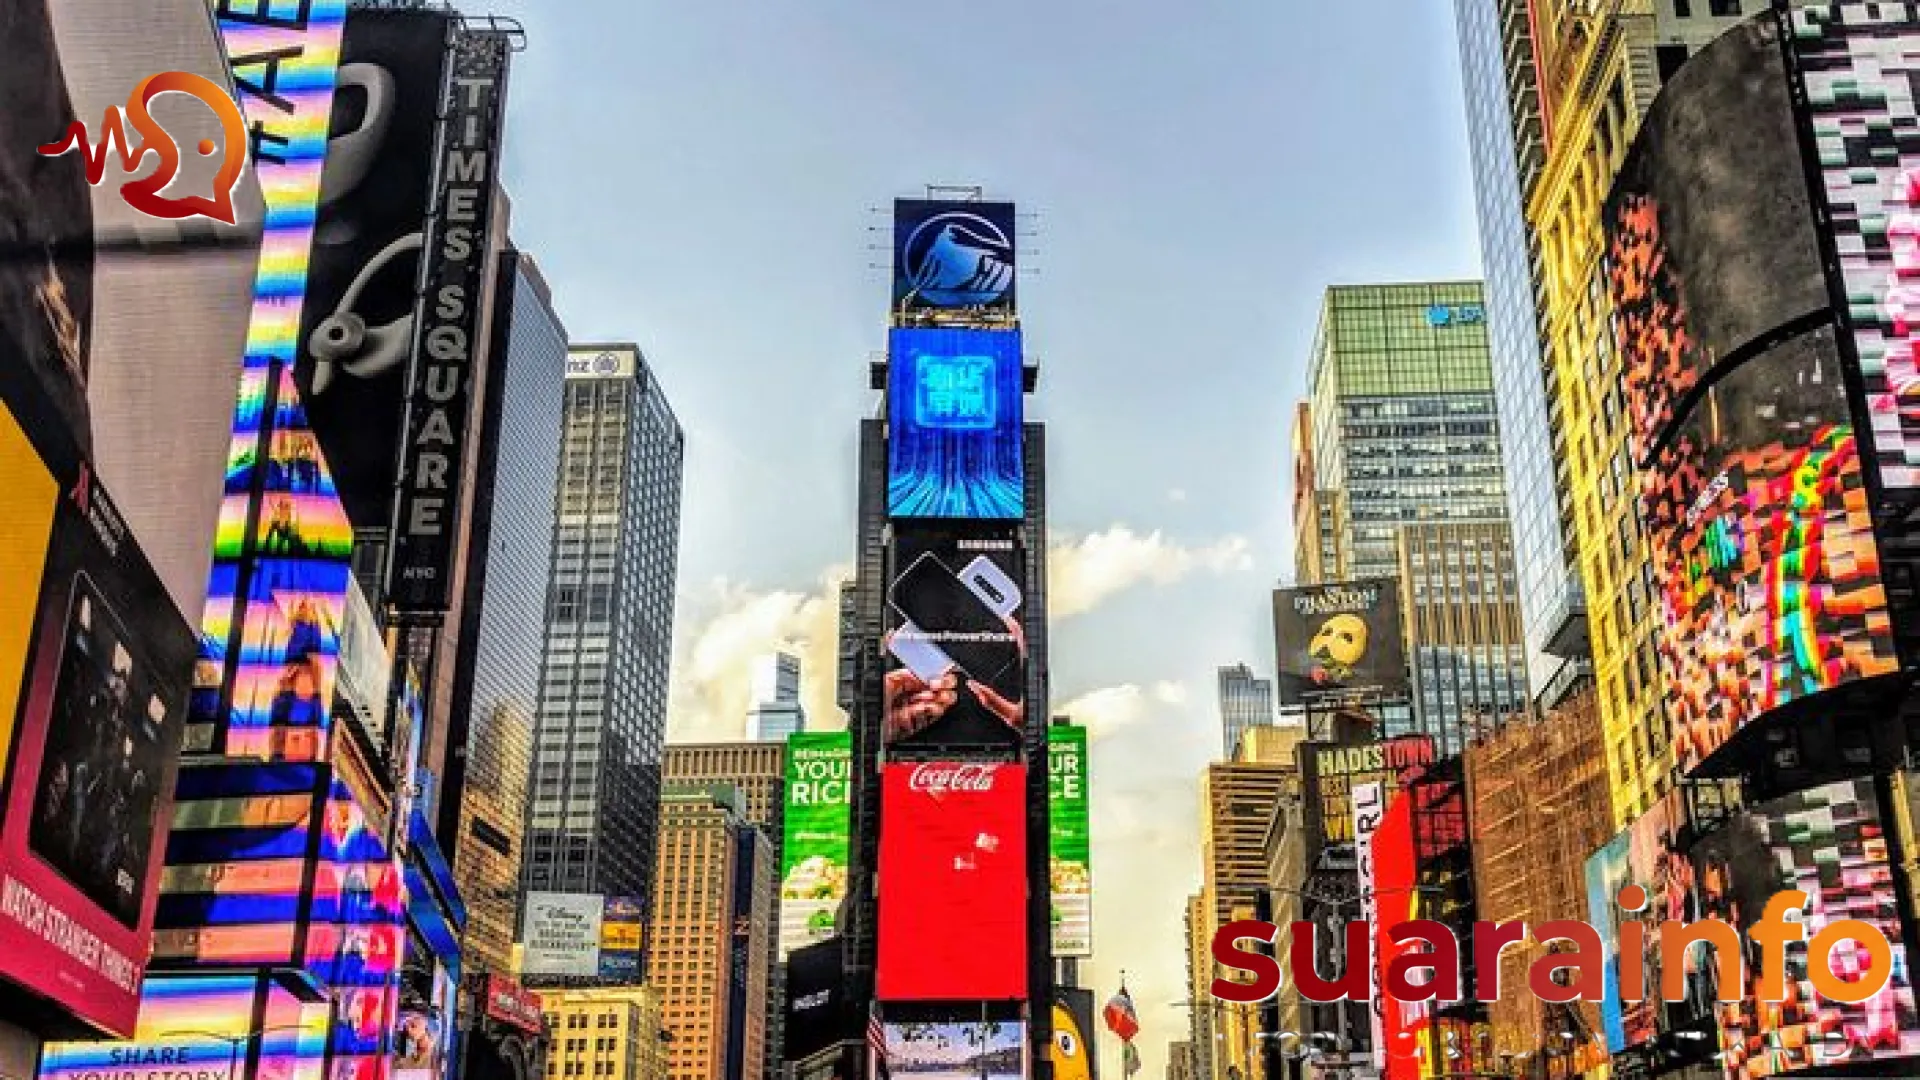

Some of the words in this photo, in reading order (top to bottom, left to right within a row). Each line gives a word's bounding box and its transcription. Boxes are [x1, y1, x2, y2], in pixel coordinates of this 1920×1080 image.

[444, 78, 494, 262] TIMES
[408, 284, 467, 536] SQUARE
[1316, 739, 1433, 776] HADESTOWN
[2, 873, 42, 935] WATCH
[43, 901, 101, 972] STRANGER
[109, 1046, 190, 1066] SHARE
